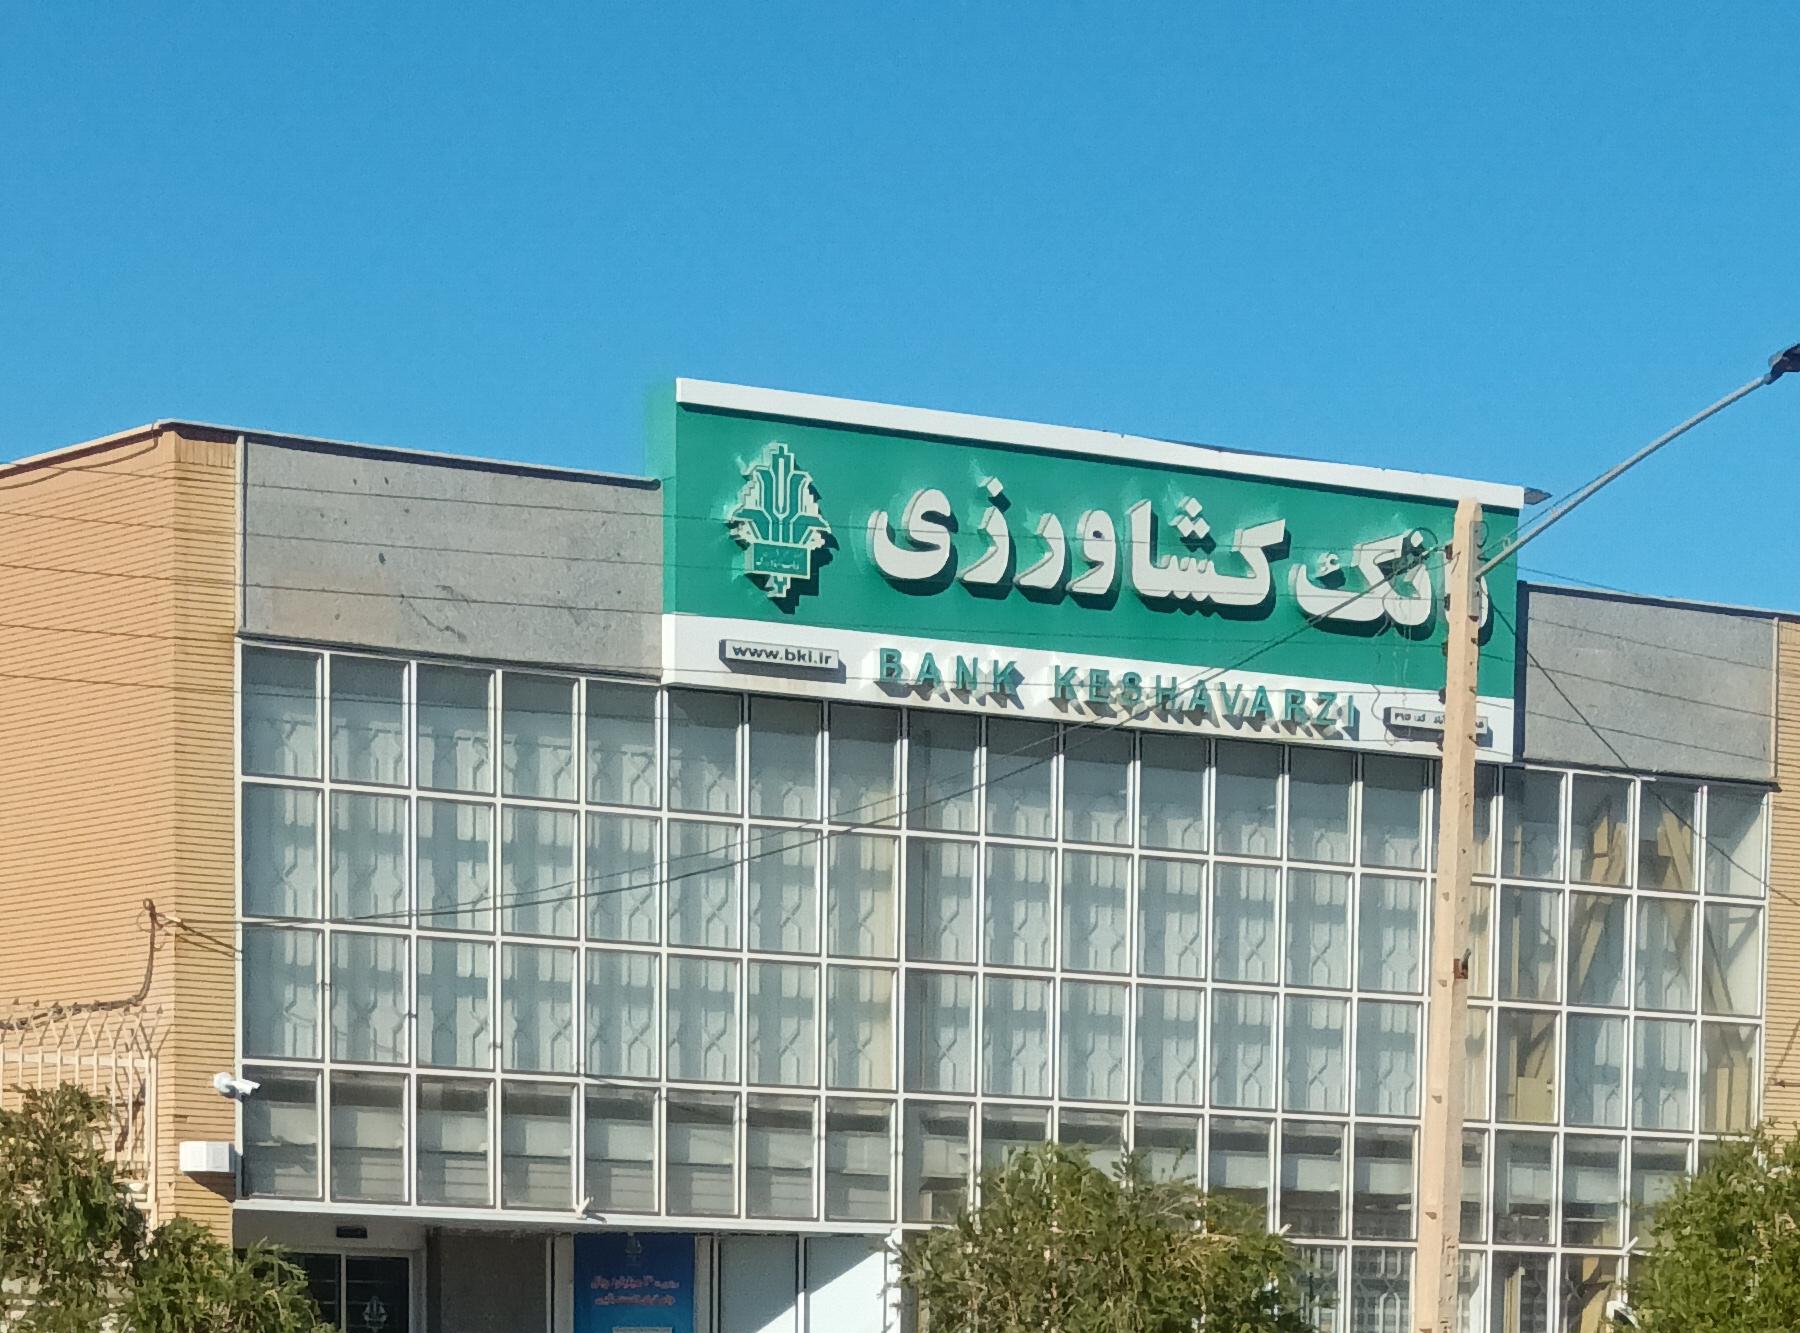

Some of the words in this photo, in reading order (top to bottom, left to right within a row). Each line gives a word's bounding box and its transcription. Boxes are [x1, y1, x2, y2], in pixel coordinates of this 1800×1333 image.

[867, 476, 1286, 606] کشاورزی
[1289, 528, 1488, 628] نک
[732, 645, 832, 665] www.bki.ir
[879, 647, 1018, 696] BANK
[1053, 664, 1356, 728] KESHAVARZI
